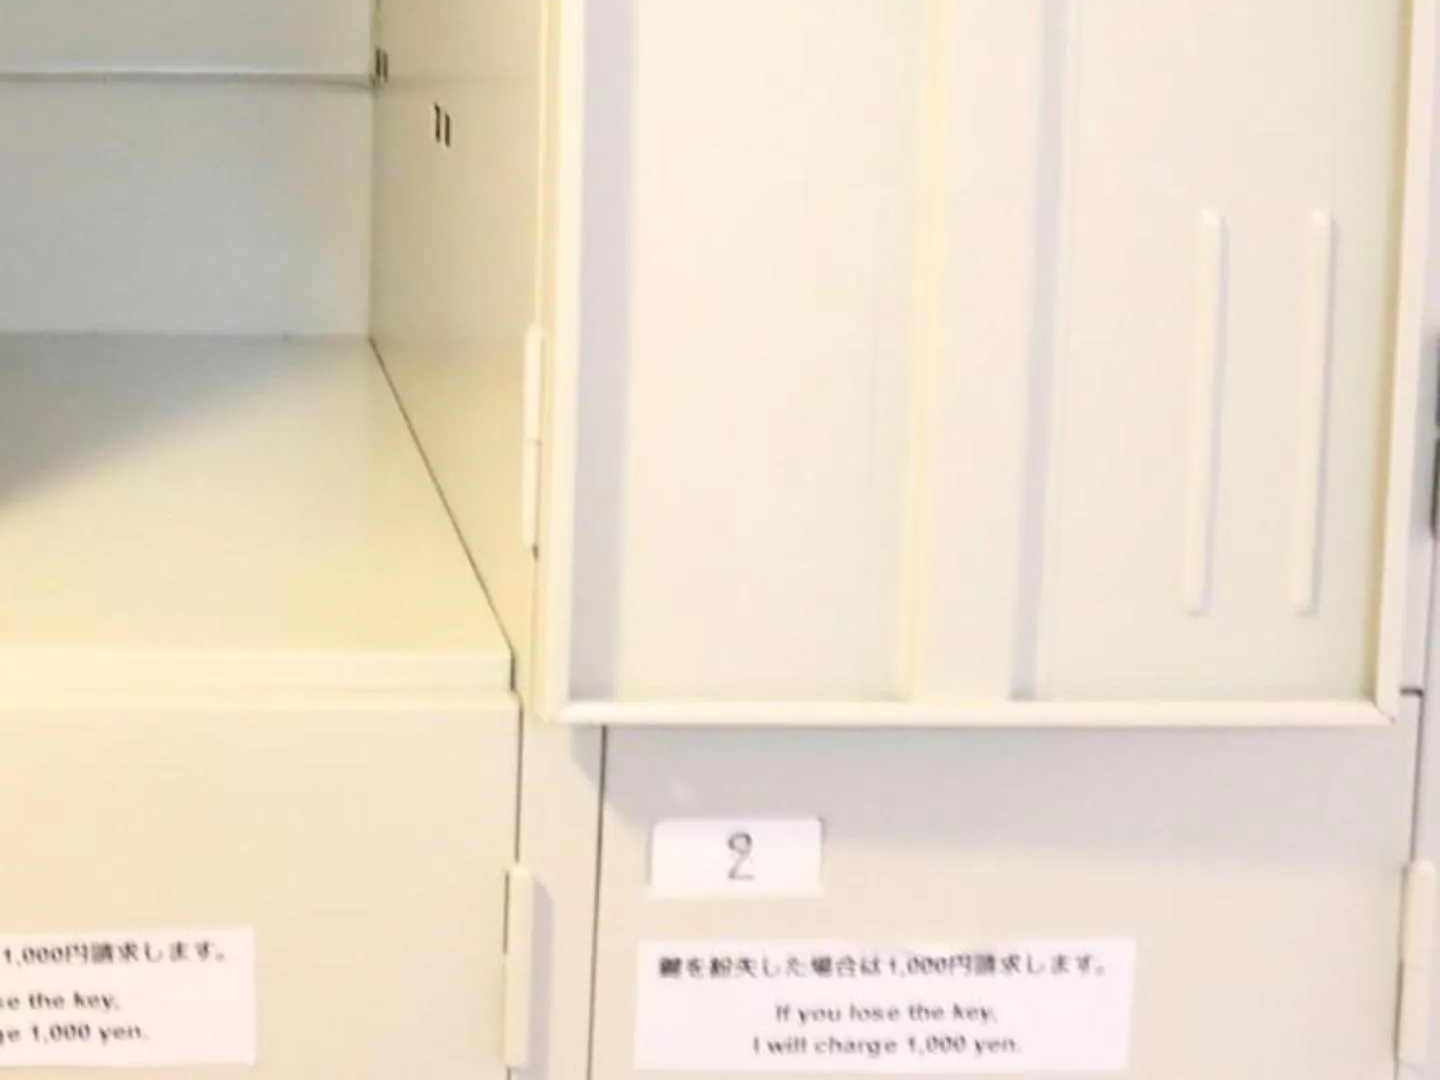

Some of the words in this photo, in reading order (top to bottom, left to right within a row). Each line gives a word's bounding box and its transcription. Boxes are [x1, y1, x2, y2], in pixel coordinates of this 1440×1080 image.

[726, 830, 755, 882] 2
[27, 991, 66, 1010] the
[775, 1003, 792, 1023] If
[797, 1007, 842, 1026] you
[848, 1003, 901, 1023] lose
[907, 1002, 946, 1022] the
[30, 1023, 92, 1044] 1,000
[766, 1035, 808, 1055] will
[813, 1035, 898, 1059] charge
[907, 1035, 968, 1056] 1,000
